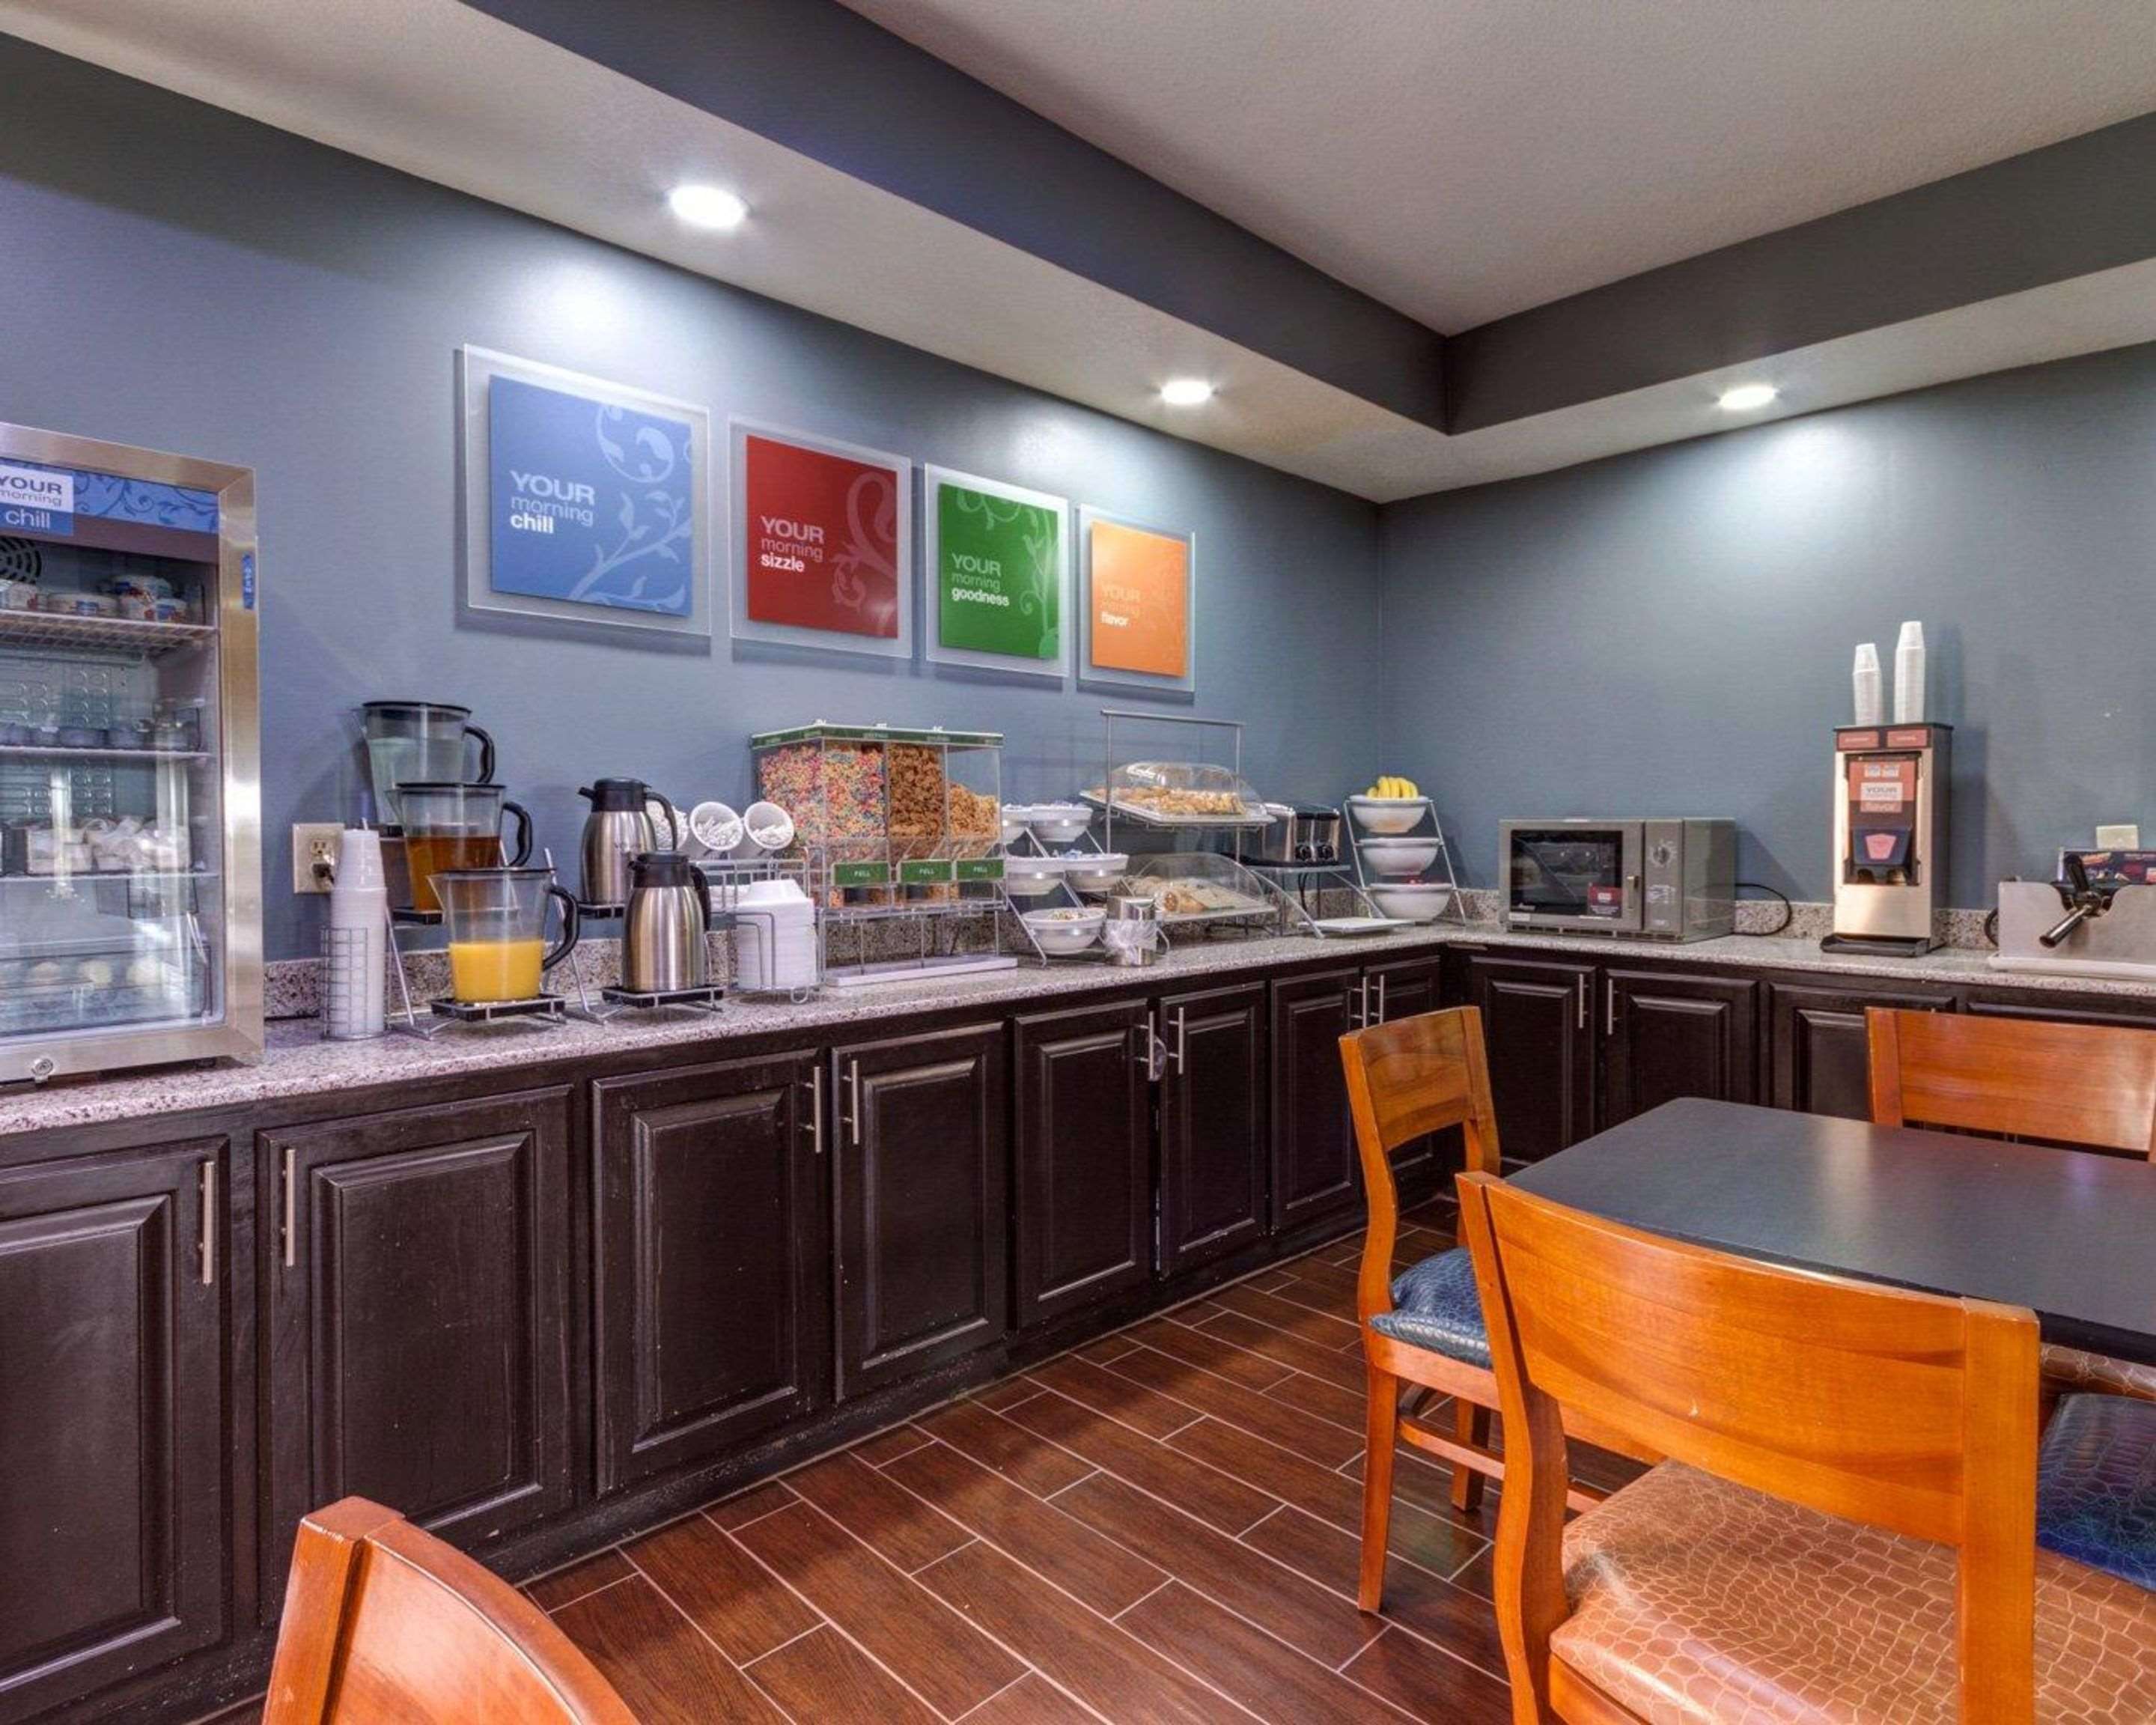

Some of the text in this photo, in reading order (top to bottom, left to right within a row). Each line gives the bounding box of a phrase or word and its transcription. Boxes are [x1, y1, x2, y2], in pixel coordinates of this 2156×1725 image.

[0, 475, 62, 495] YOUR
[510, 470, 595, 506] YOUR
[5, 508, 50, 529] chill
[511, 495, 594, 527] morning
[510, 511, 554, 534] chill
[761, 515, 824, 545] YOUR
[761, 538, 823, 563] morning
[761, 551, 805, 573] sizzle
[951, 553, 1001, 577] YOUR
[951, 572, 1001, 594] morning
[1101, 584, 1141, 602] YOUR
[951, 587, 1010, 606] goodness
